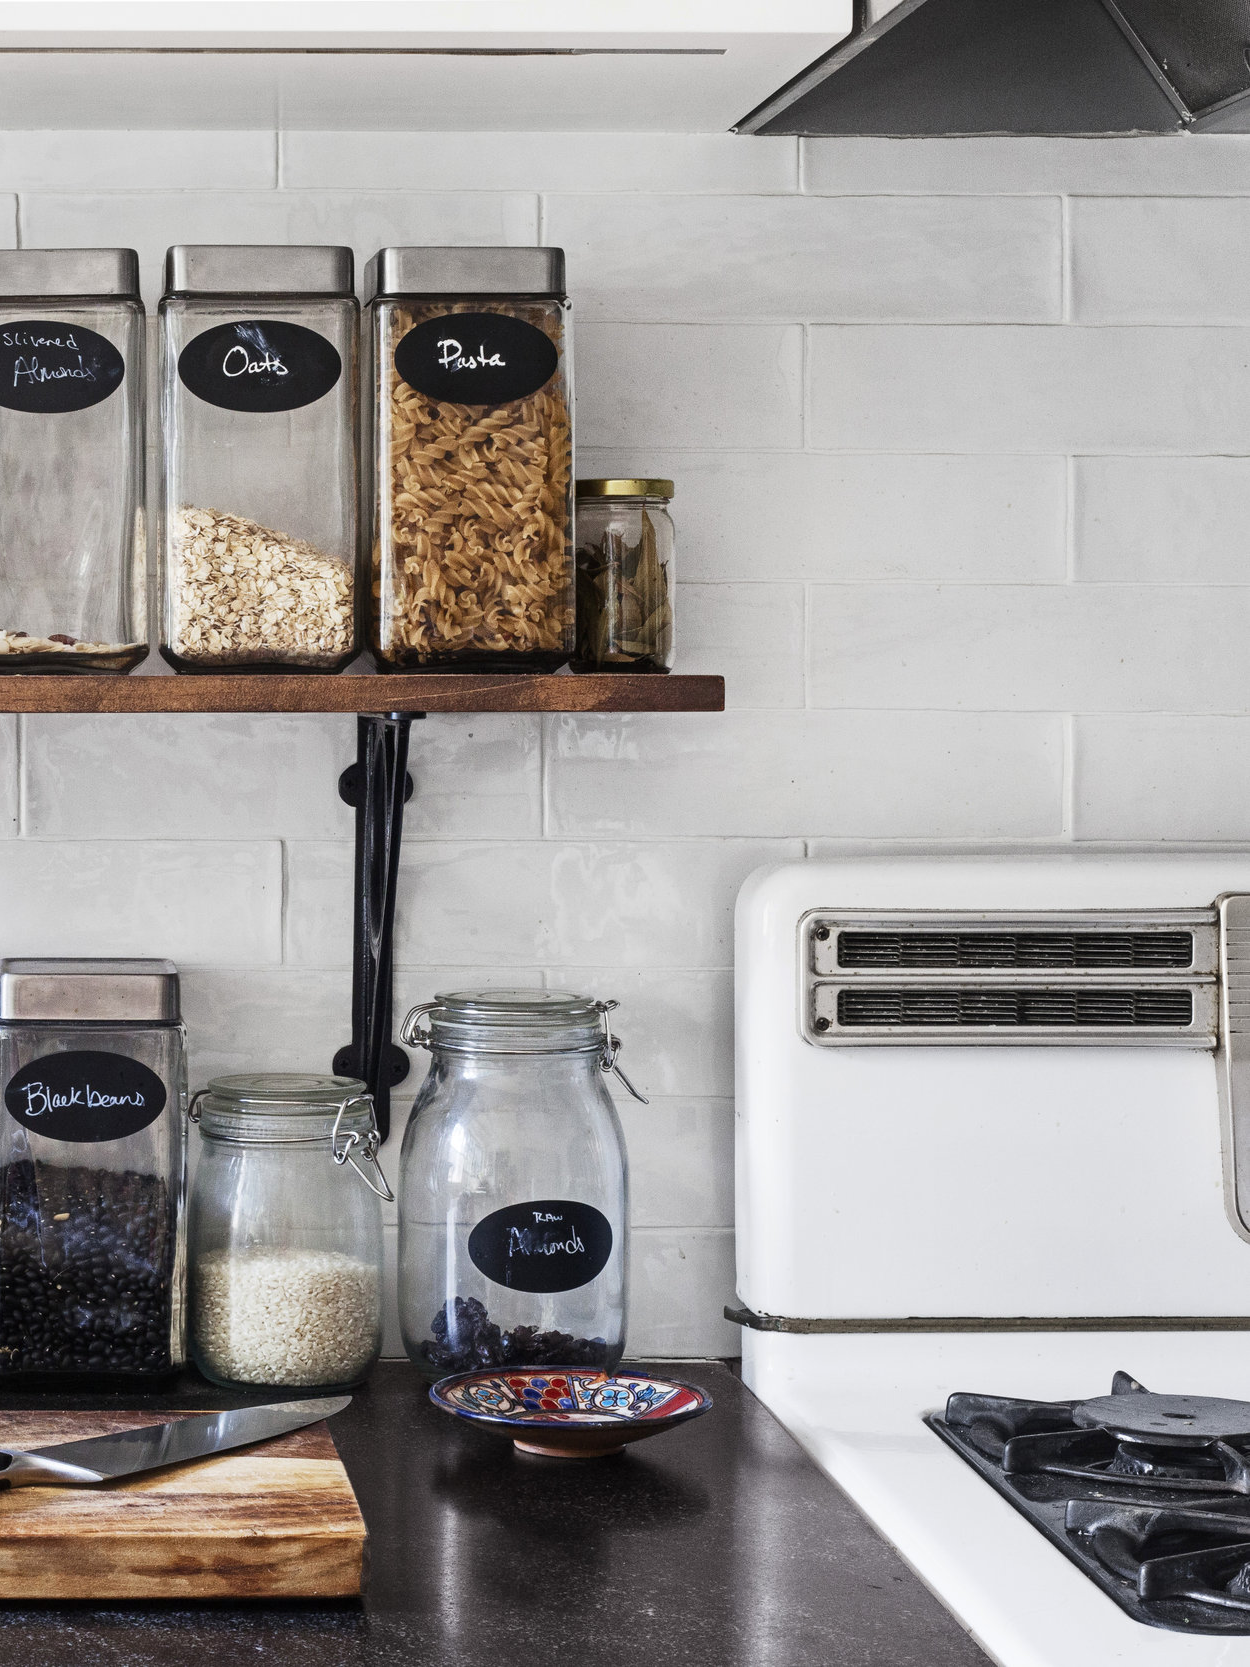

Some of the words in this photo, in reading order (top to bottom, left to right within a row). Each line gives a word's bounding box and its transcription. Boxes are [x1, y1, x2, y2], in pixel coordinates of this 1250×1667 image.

[2, 331, 80, 351] Slivered
[436, 338, 506, 370] Pasta
[13, 354, 97, 387] Almonds
[222, 345, 289, 378] Oats
